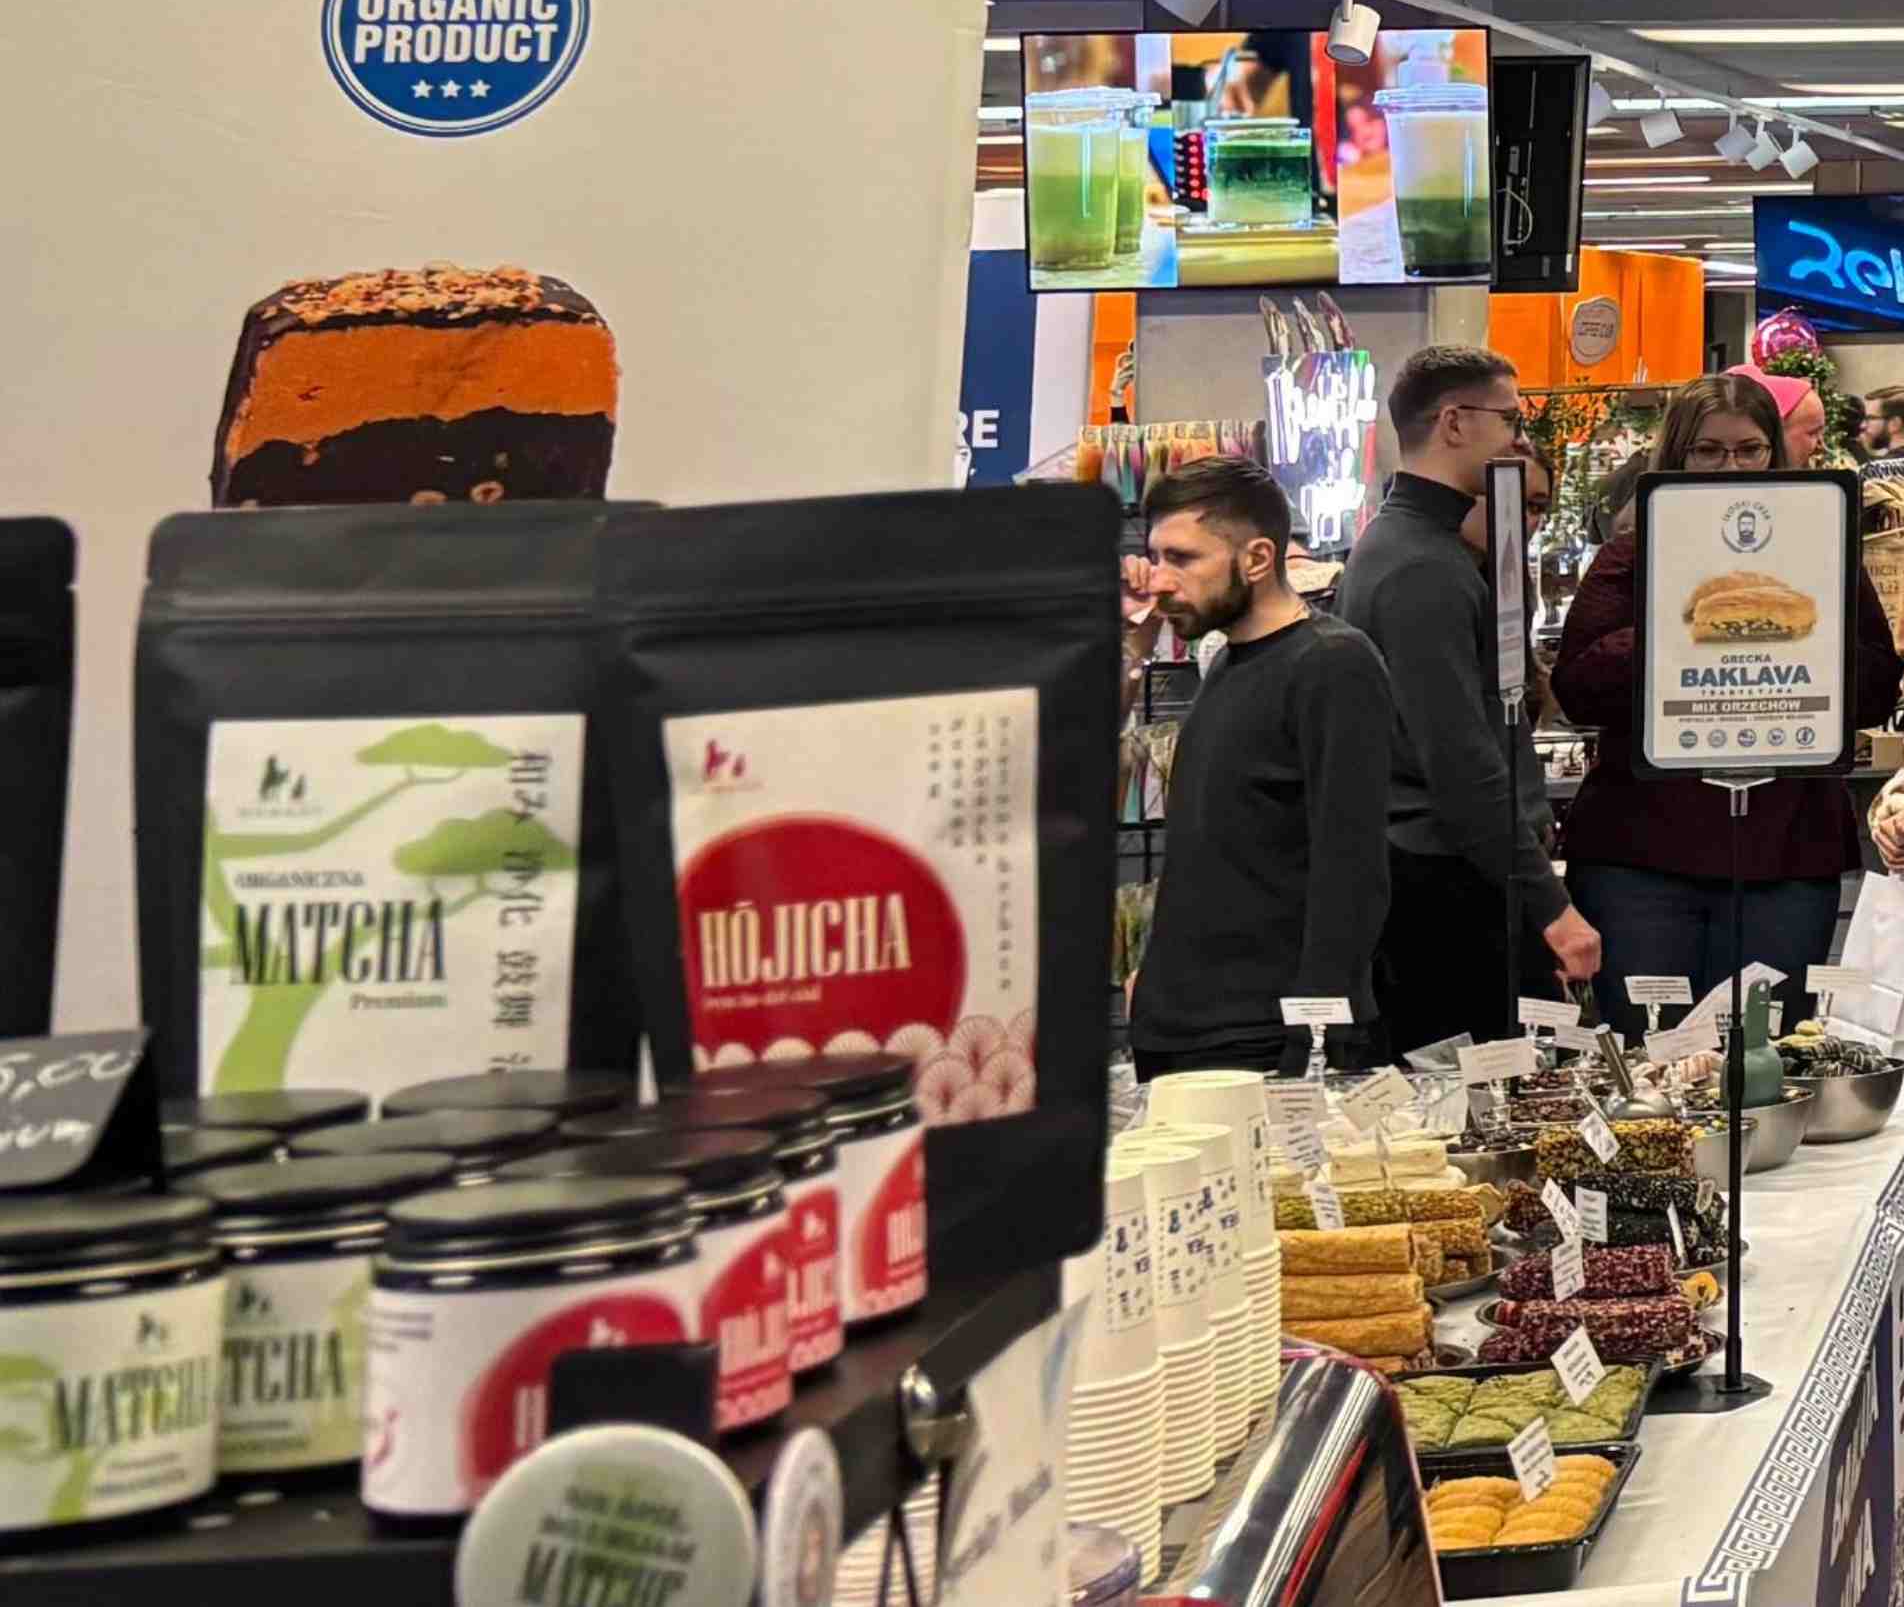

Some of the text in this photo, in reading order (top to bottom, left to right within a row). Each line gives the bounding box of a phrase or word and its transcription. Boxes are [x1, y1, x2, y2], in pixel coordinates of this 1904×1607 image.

[354, 23, 558, 64] PRODUCT
[1721, 653, 1772, 665] GRECKA
[1680, 664, 1812, 688] BAKLAVA
[1691, 701, 1719, 714] MIX
[230, 896, 448, 987] MATCHA
[223, 1330, 347, 1408] TCHA
